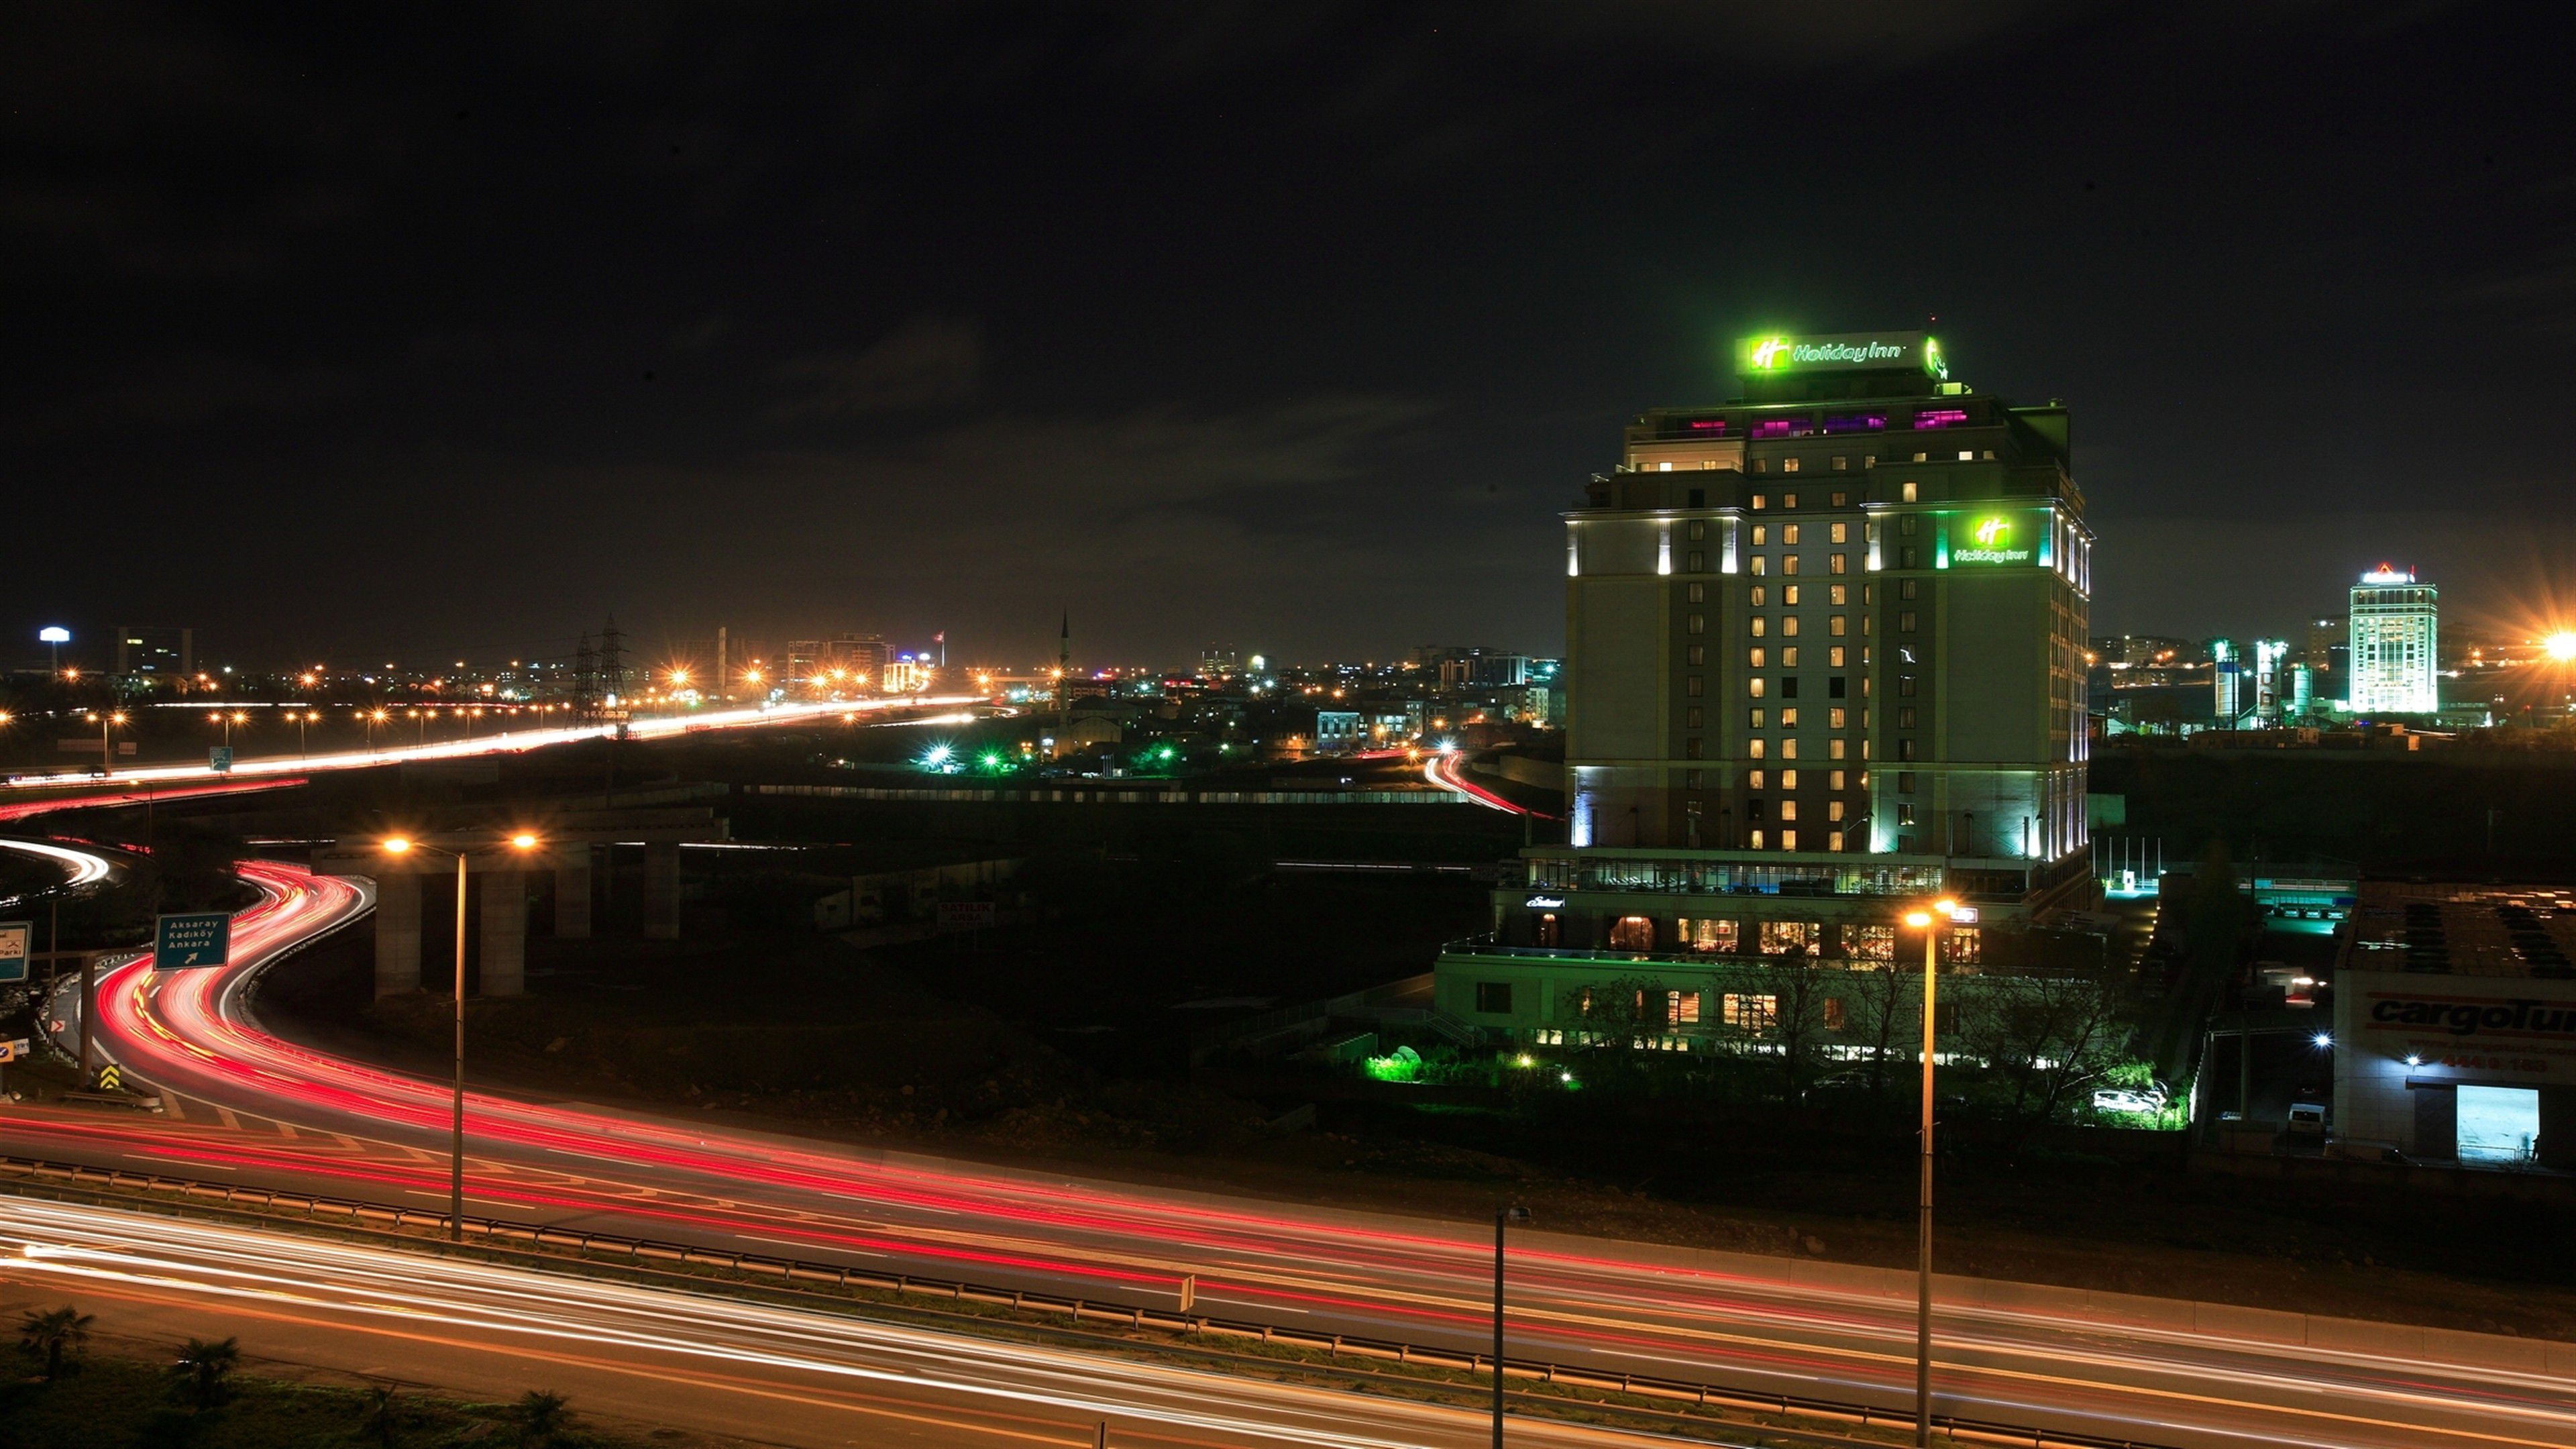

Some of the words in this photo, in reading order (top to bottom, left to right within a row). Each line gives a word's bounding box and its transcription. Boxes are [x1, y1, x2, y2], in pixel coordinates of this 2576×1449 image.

[1792, 343, 1868, 362] Holiday
[1868, 341, 1901, 358] Inn
[1953, 549, 2005, 564] Holiday
[2006, 549, 2029, 560] Inn
[170, 920, 218, 929] Aksaray
[168, 940, 210, 949] Ankara
